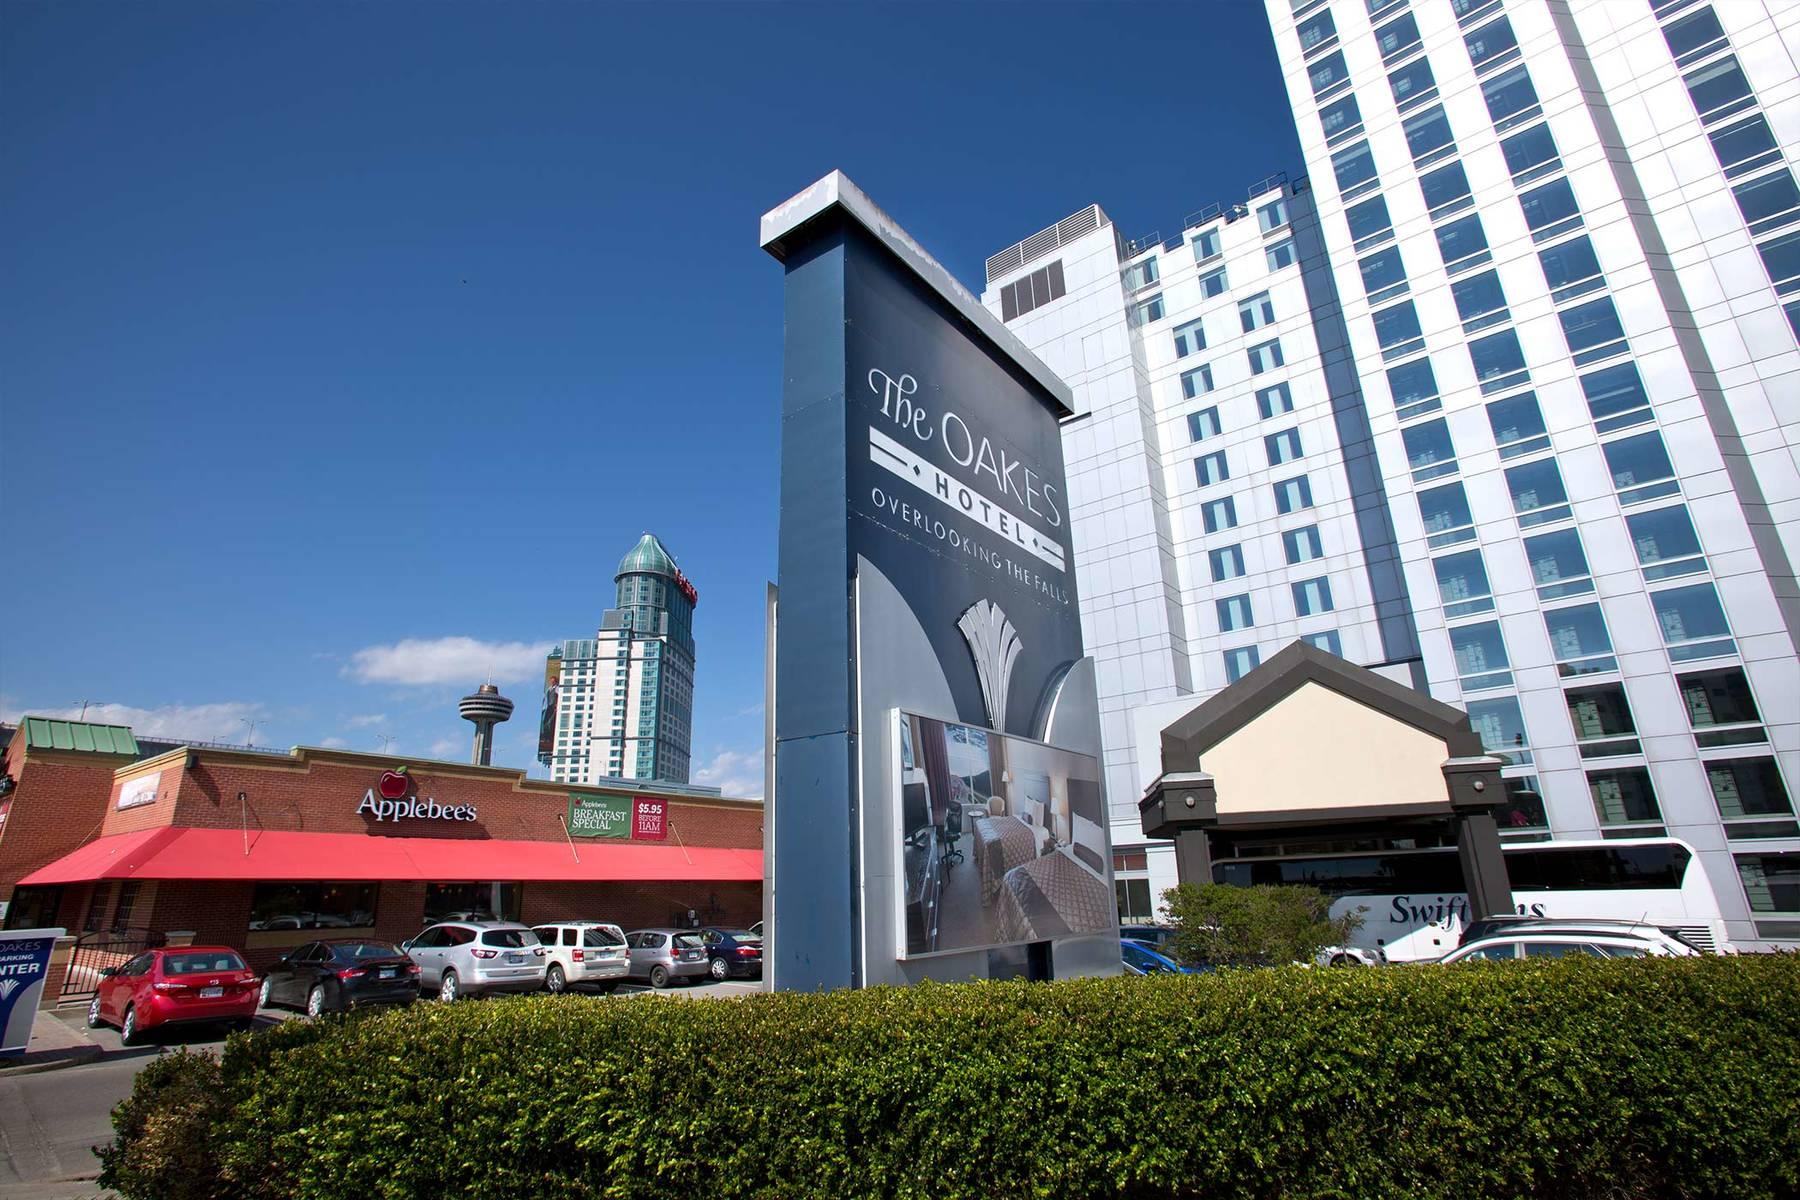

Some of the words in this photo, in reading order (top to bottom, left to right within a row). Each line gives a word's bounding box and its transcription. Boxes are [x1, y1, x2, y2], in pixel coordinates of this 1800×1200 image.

[868, 368, 933, 441] The
[942, 412, 1061, 527] OAKES
[935, 472, 1026, 545] HOTEL
[872, 487, 1001, 569] OVERLOOKING
[1005, 559, 1031, 585] THE
[1034, 577, 1069, 605] FALLS
[355, 788, 478, 823] Applebee's
[638, 803, 662, 814] $5.95
[573, 808, 627, 822] BREAKFAST
[638, 814, 661, 823] BEFORE
[572, 818, 611, 830] SPECIAL
[638, 821, 661, 832] 11AM
[1390, 896, 1467, 930] Swift
[0, 954, 34, 962] ARKING
[0, 963, 40, 975] NTER
